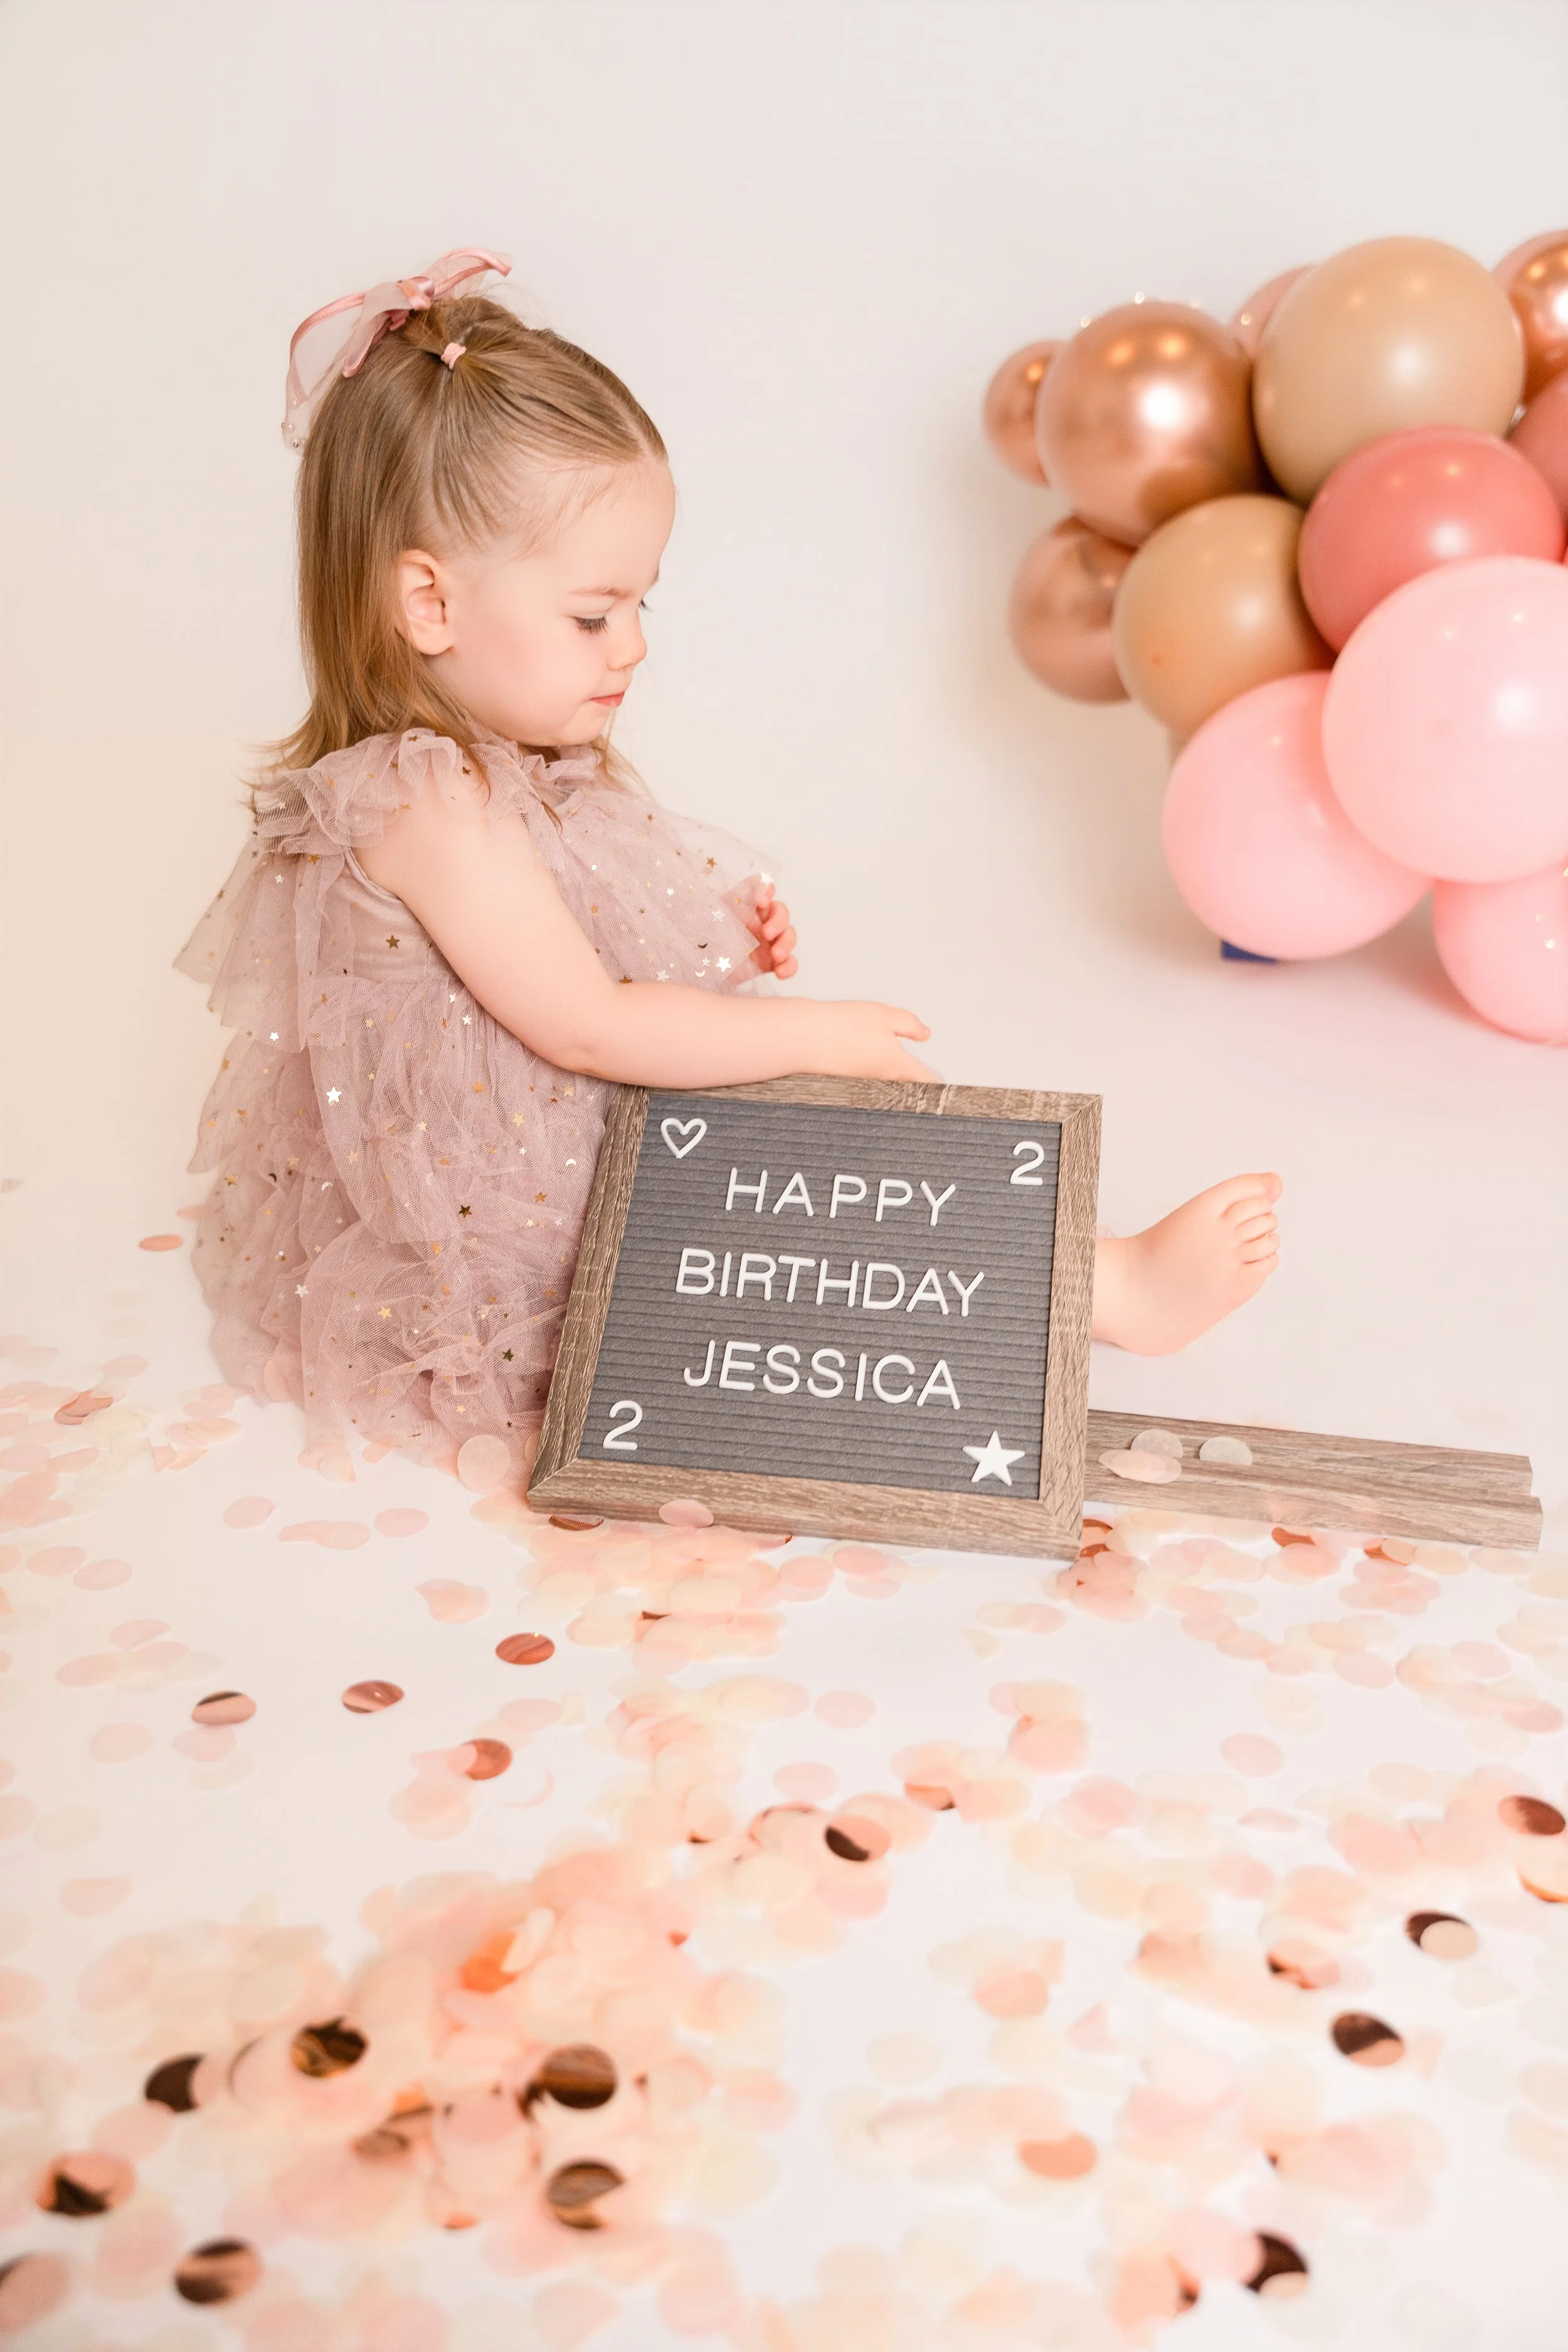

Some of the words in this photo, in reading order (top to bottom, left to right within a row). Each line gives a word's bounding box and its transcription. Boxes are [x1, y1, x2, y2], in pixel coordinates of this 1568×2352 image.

[1009, 1140, 1046, 1186] 2
[724, 1167, 957, 1227] HAPPY
[675, 1247, 986, 1318] BIRTHDAY
[682, 1338, 961, 1411] JESSICA
[602, 1399, 644, 1451] 2
